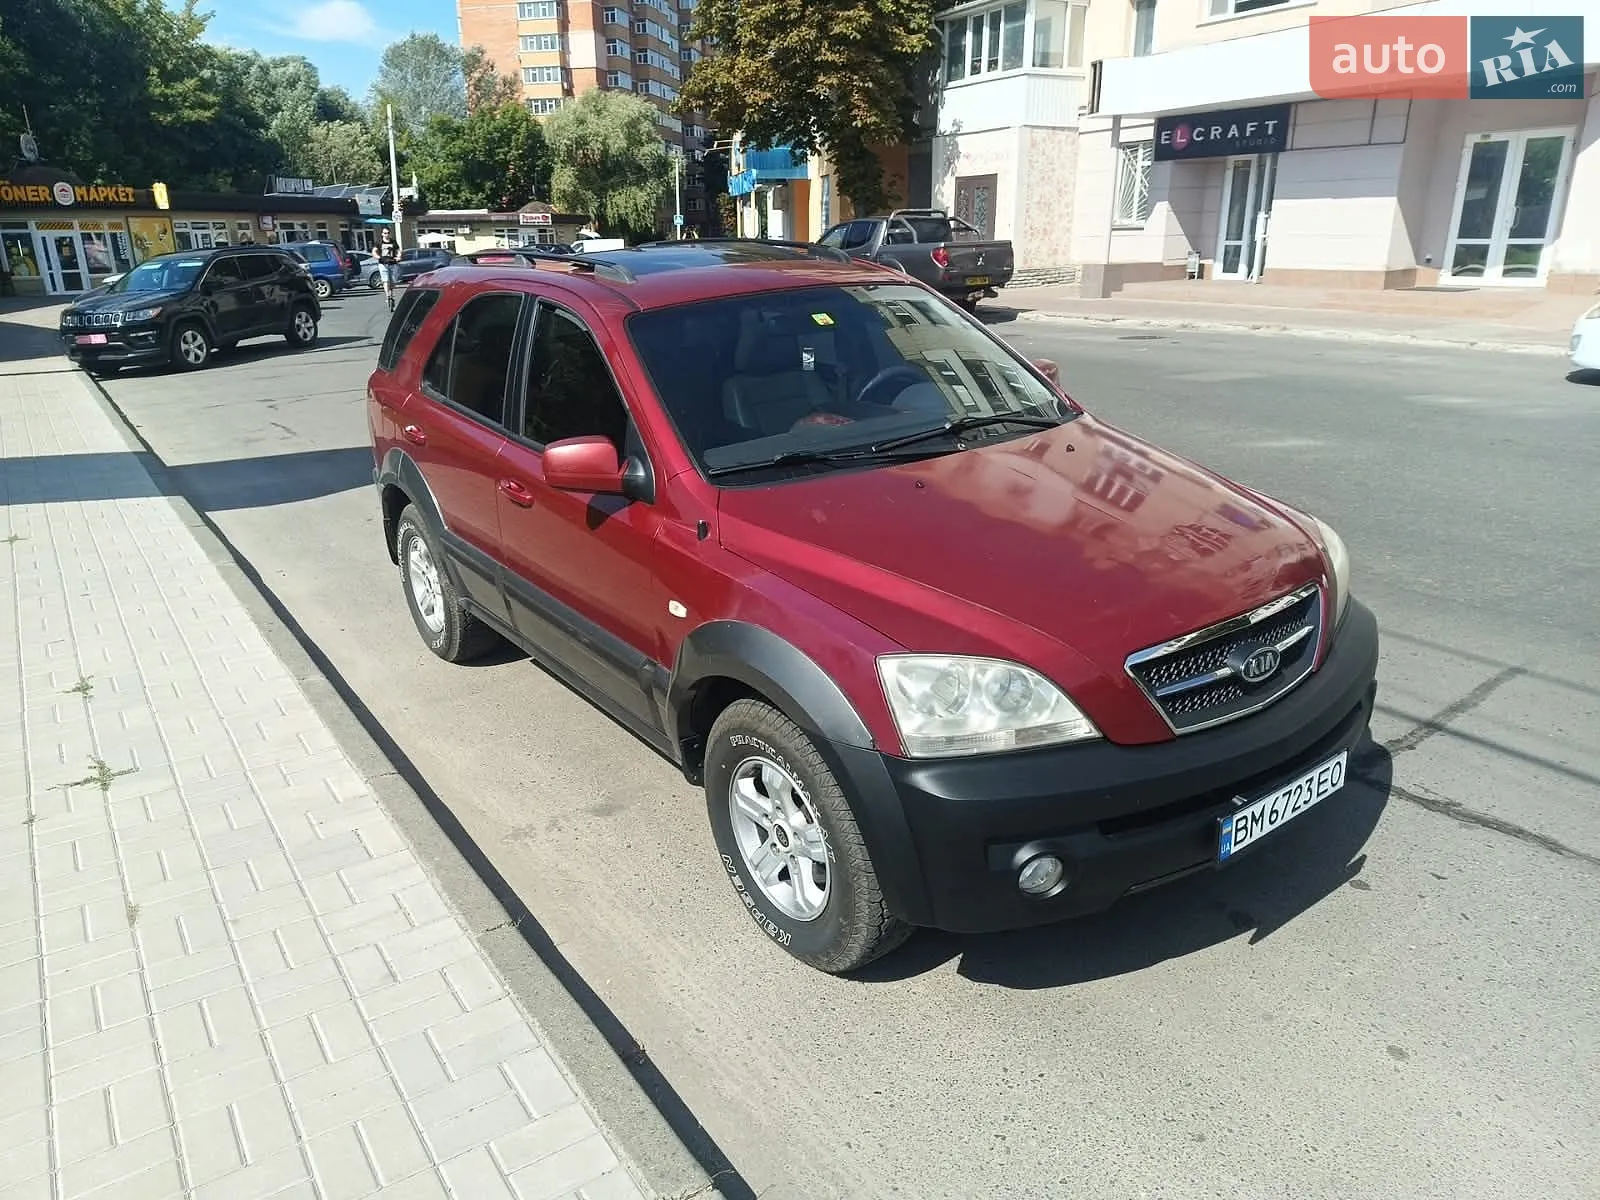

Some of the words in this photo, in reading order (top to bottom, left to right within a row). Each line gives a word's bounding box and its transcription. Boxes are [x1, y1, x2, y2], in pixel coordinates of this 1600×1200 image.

[1161, 120, 1278, 144] ELCRAFT
[1249, 652, 1276, 677] KIA
[1220, 842, 1231, 854] UA
